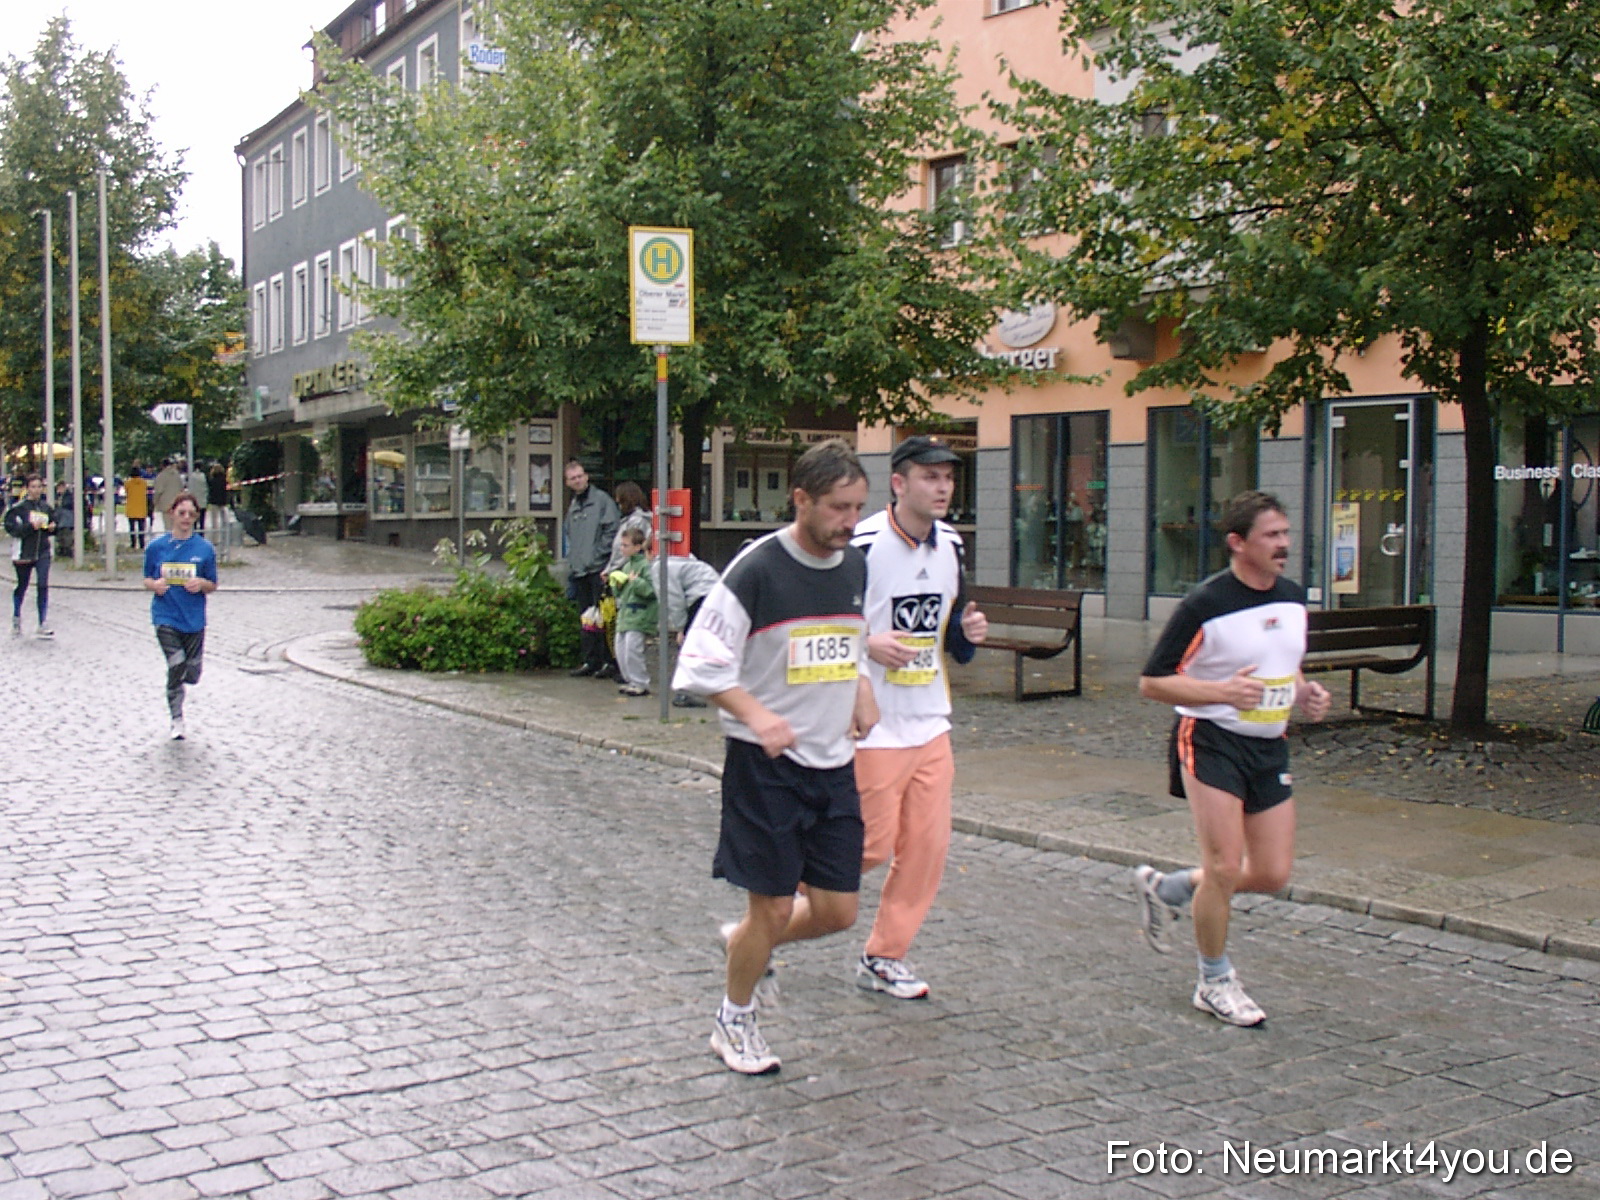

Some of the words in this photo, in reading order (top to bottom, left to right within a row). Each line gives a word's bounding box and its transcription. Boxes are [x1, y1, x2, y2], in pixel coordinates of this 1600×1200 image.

[651, 247, 672, 273] H
[292, 358, 357, 398] OPTIKER
[162, 406, 183, 421] WC
[1494, 464, 1561, 481] Business
[805, 636, 851, 662] 1685
